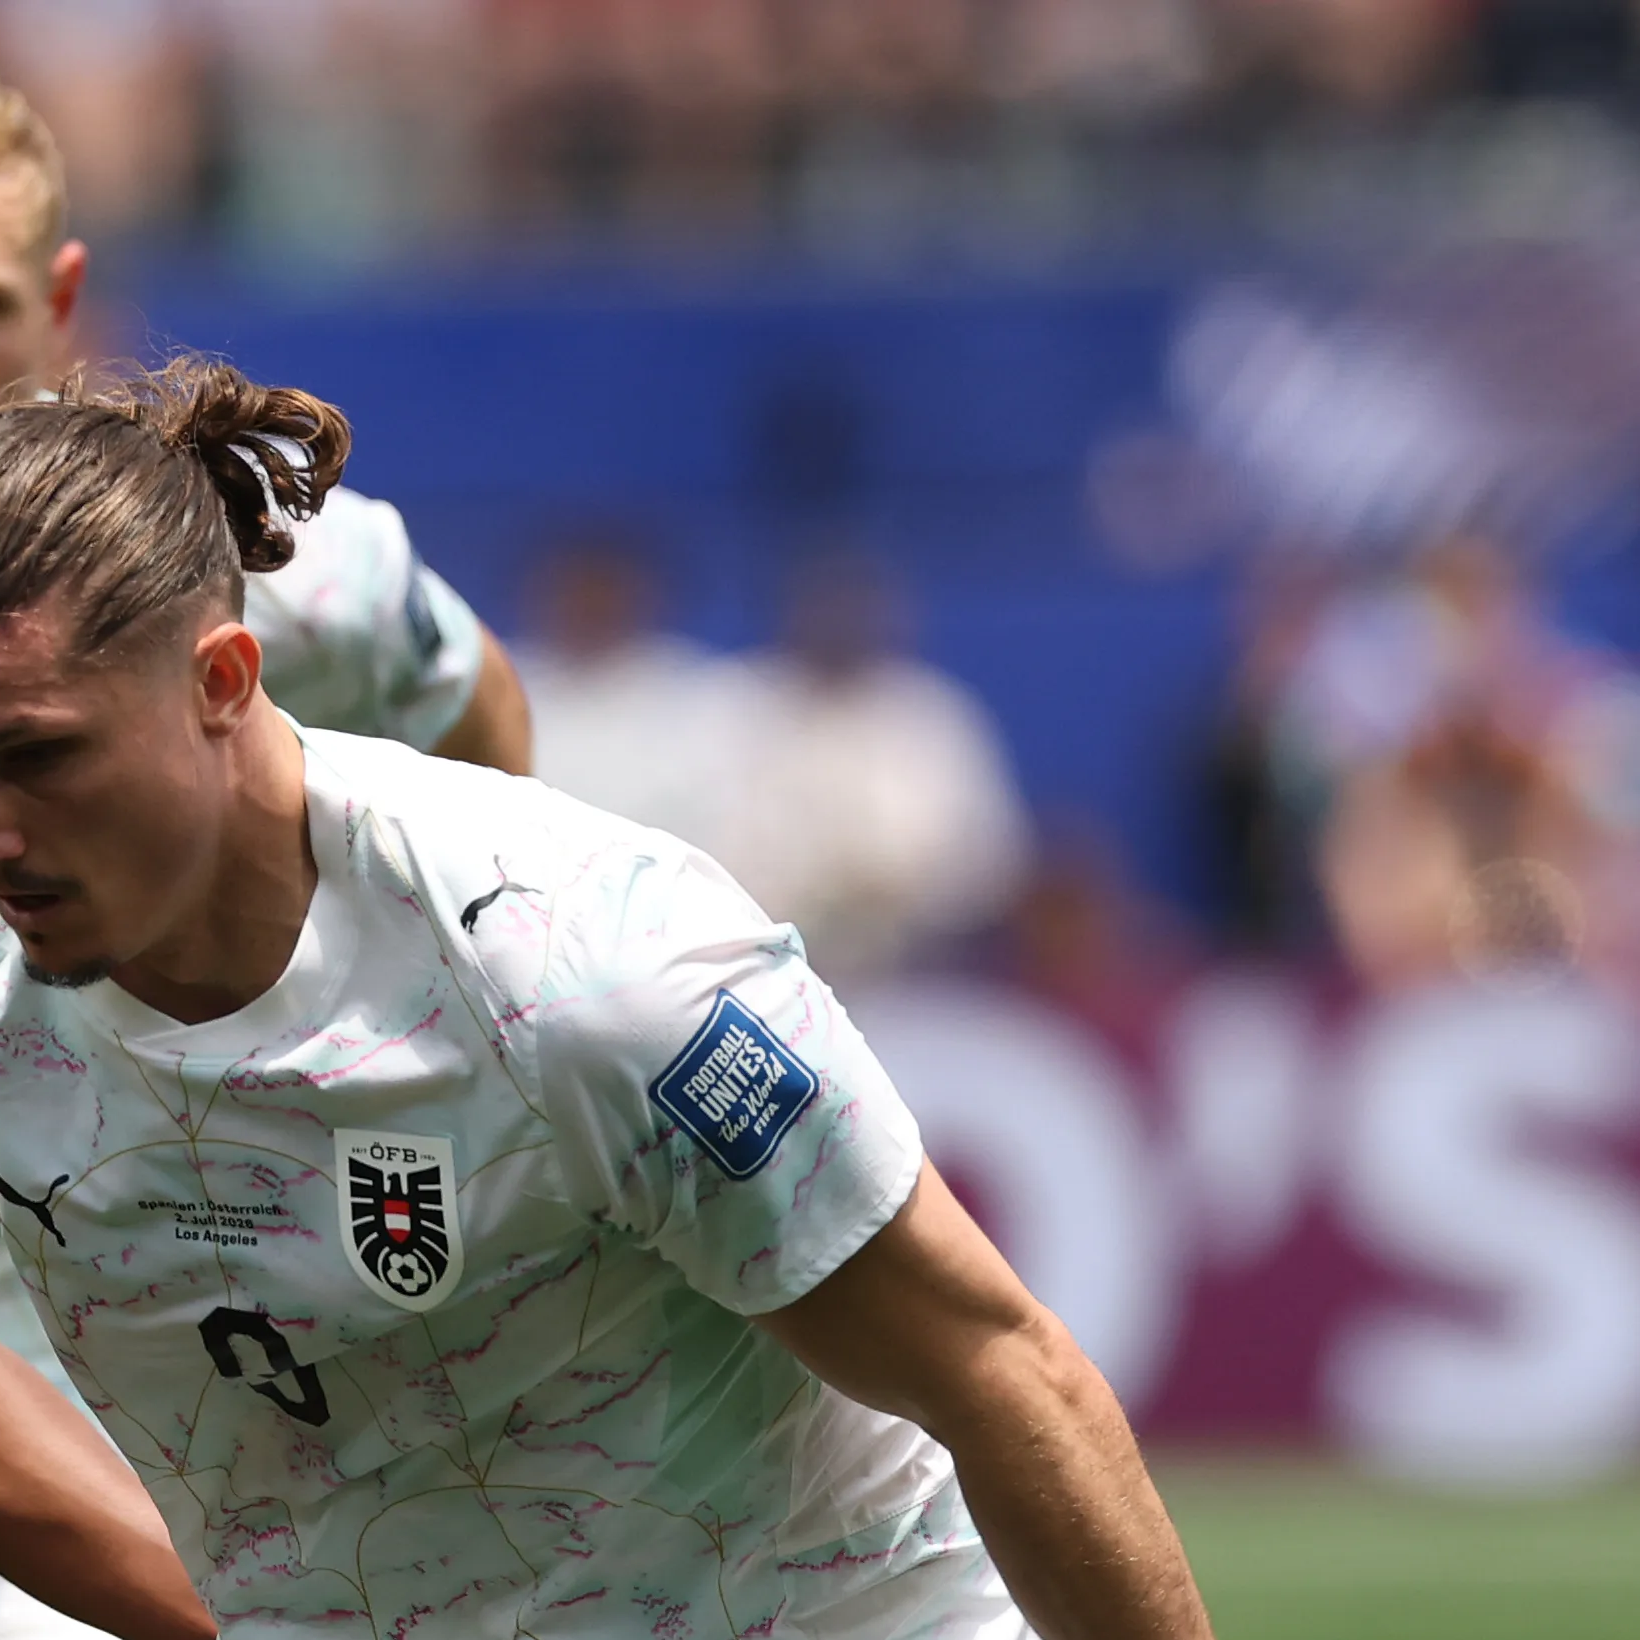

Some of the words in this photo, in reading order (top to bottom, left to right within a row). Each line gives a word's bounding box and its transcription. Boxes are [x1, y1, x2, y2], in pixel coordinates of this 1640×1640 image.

[682, 1023, 748, 1103] FOOTBALL
[698, 1037, 766, 1122] UNITES
[719, 1113, 750, 1143] the
[741, 1052, 787, 1117] World
[754, 1101, 781, 1136] FIFA
[370, 1141, 417, 1163] ÖFB
[175, 1227, 199, 1241] Los
[203, 1229, 258, 1246] Angeles
[192, 1214, 217, 1227] Juli
[220, 1215, 254, 1229] 2026
